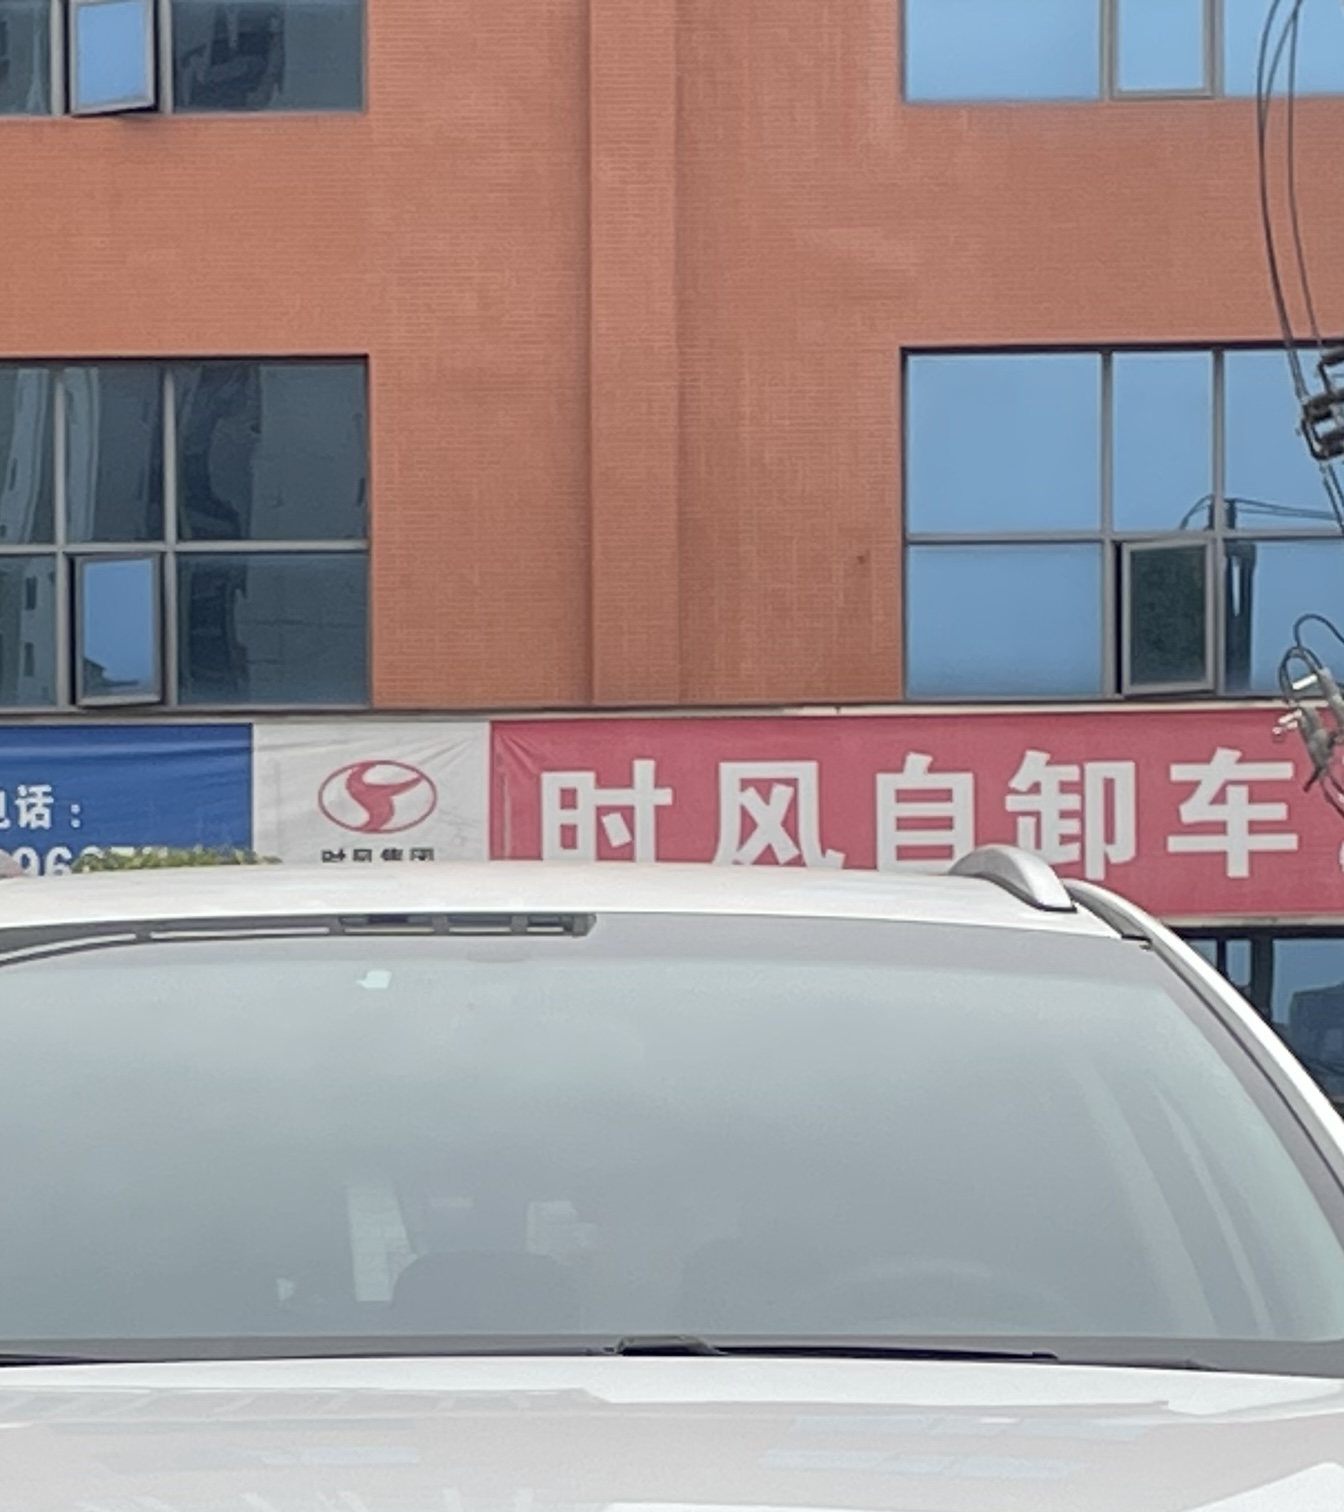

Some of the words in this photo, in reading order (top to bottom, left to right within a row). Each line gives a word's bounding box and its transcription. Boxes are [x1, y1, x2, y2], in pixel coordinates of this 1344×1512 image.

[540, 748, 1299, 881] 时风自卸车
